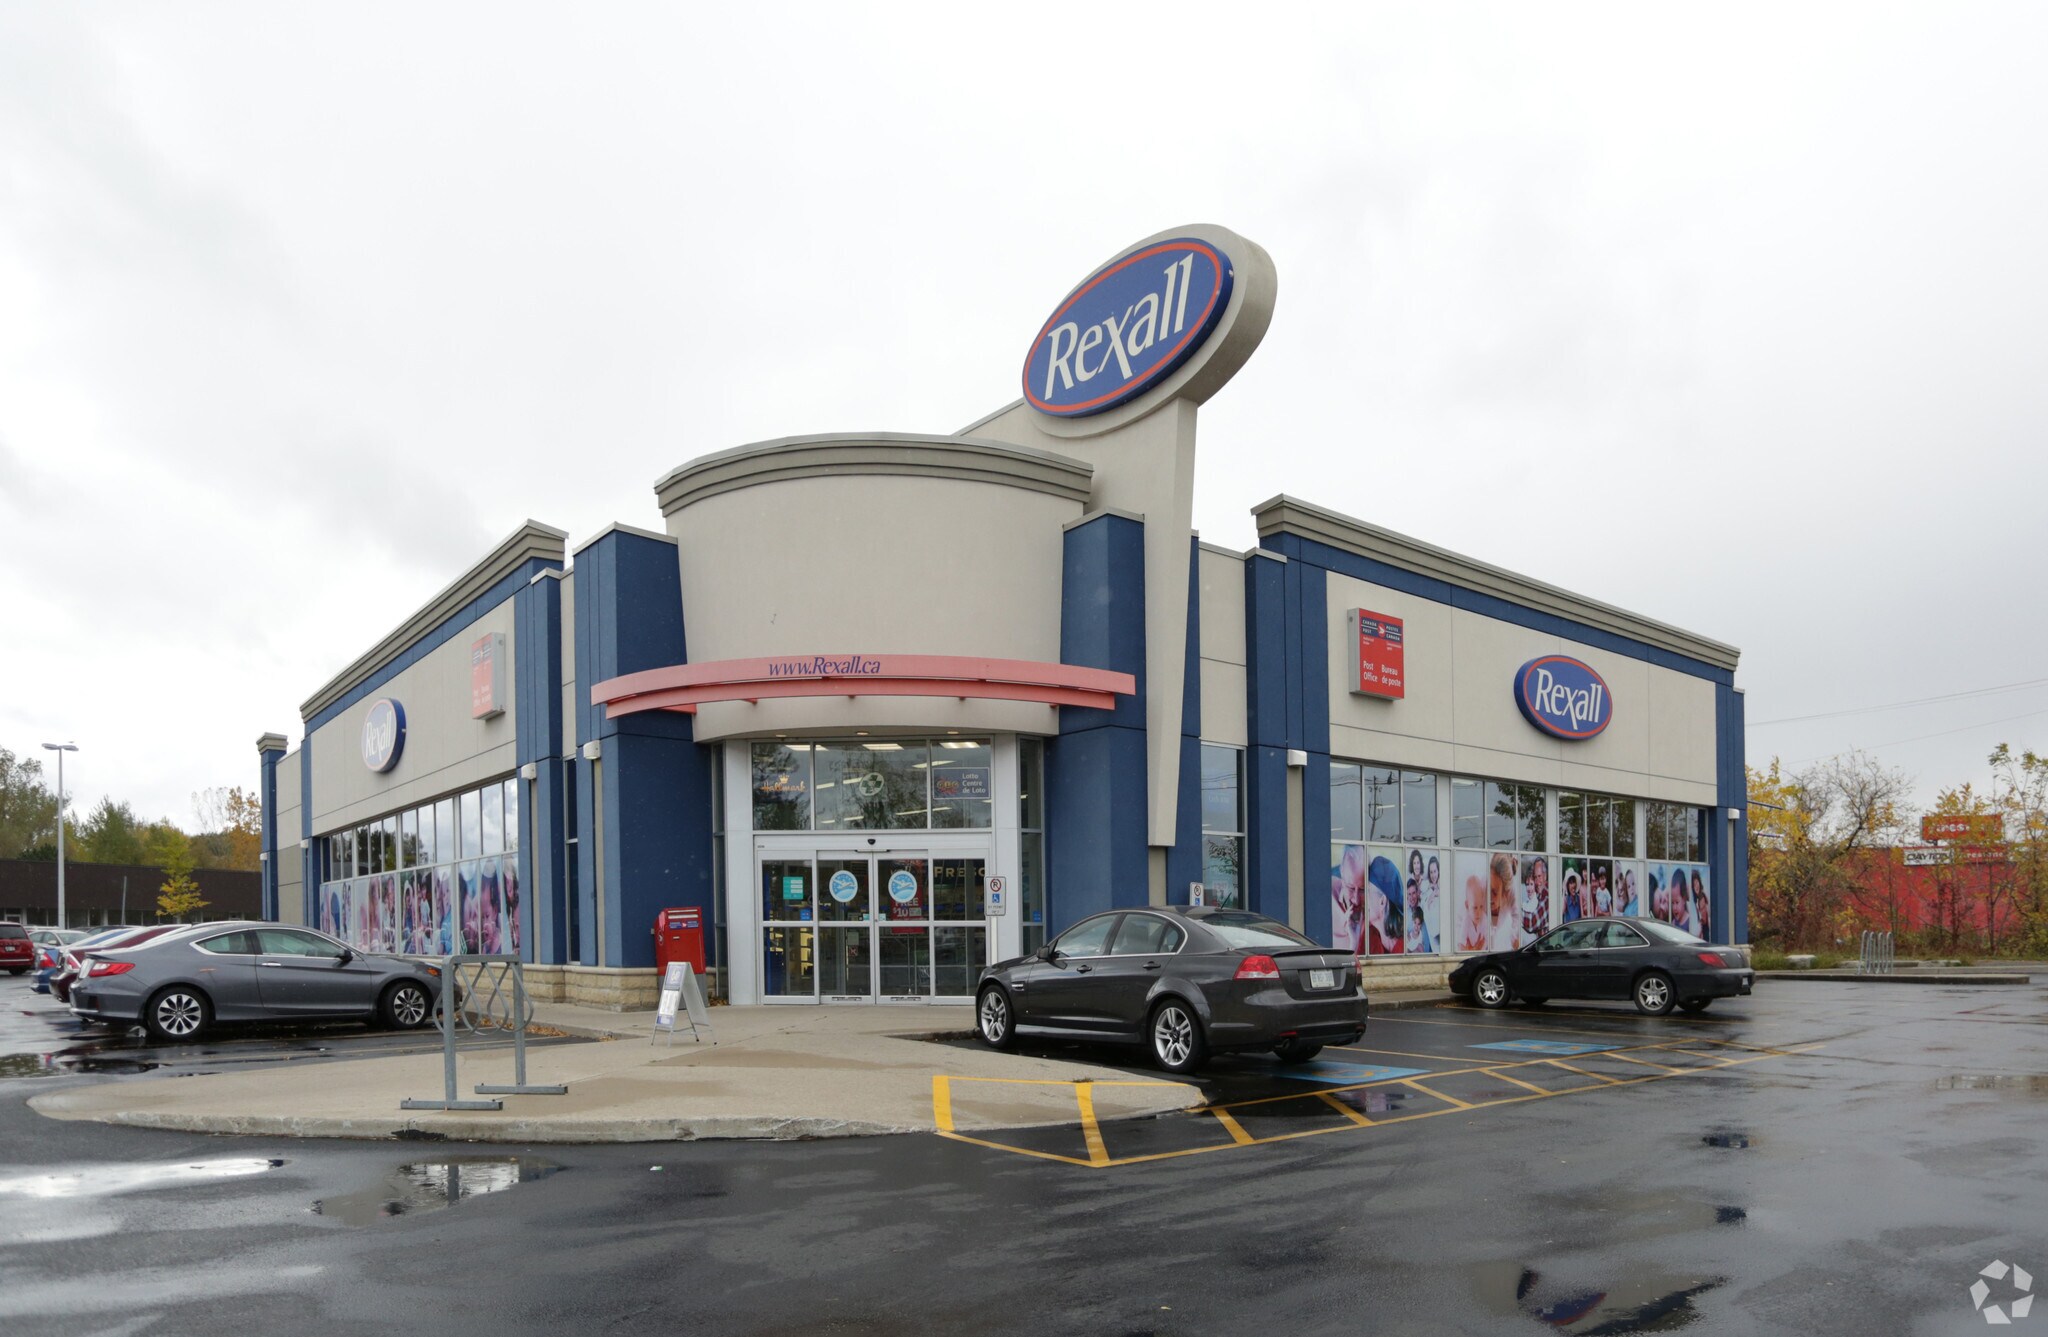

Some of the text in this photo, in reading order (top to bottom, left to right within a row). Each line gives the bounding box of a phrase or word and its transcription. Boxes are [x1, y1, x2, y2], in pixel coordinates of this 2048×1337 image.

[1045, 252, 1194, 400] Rexall
[769, 655, 881, 676] www.Rexall.ca
[1363, 660, 1374, 670] Post
[1381, 664, 1398, 676] Bureau
[1363, 671, 1378, 682] Office
[1381, 676, 1401, 687] de poste
[1535, 668, 1602, 730] Rexall
[365, 711, 392, 762] Rexall
[760, 781, 808, 794] Hallmark
[934, 866, 985, 878] PREC
